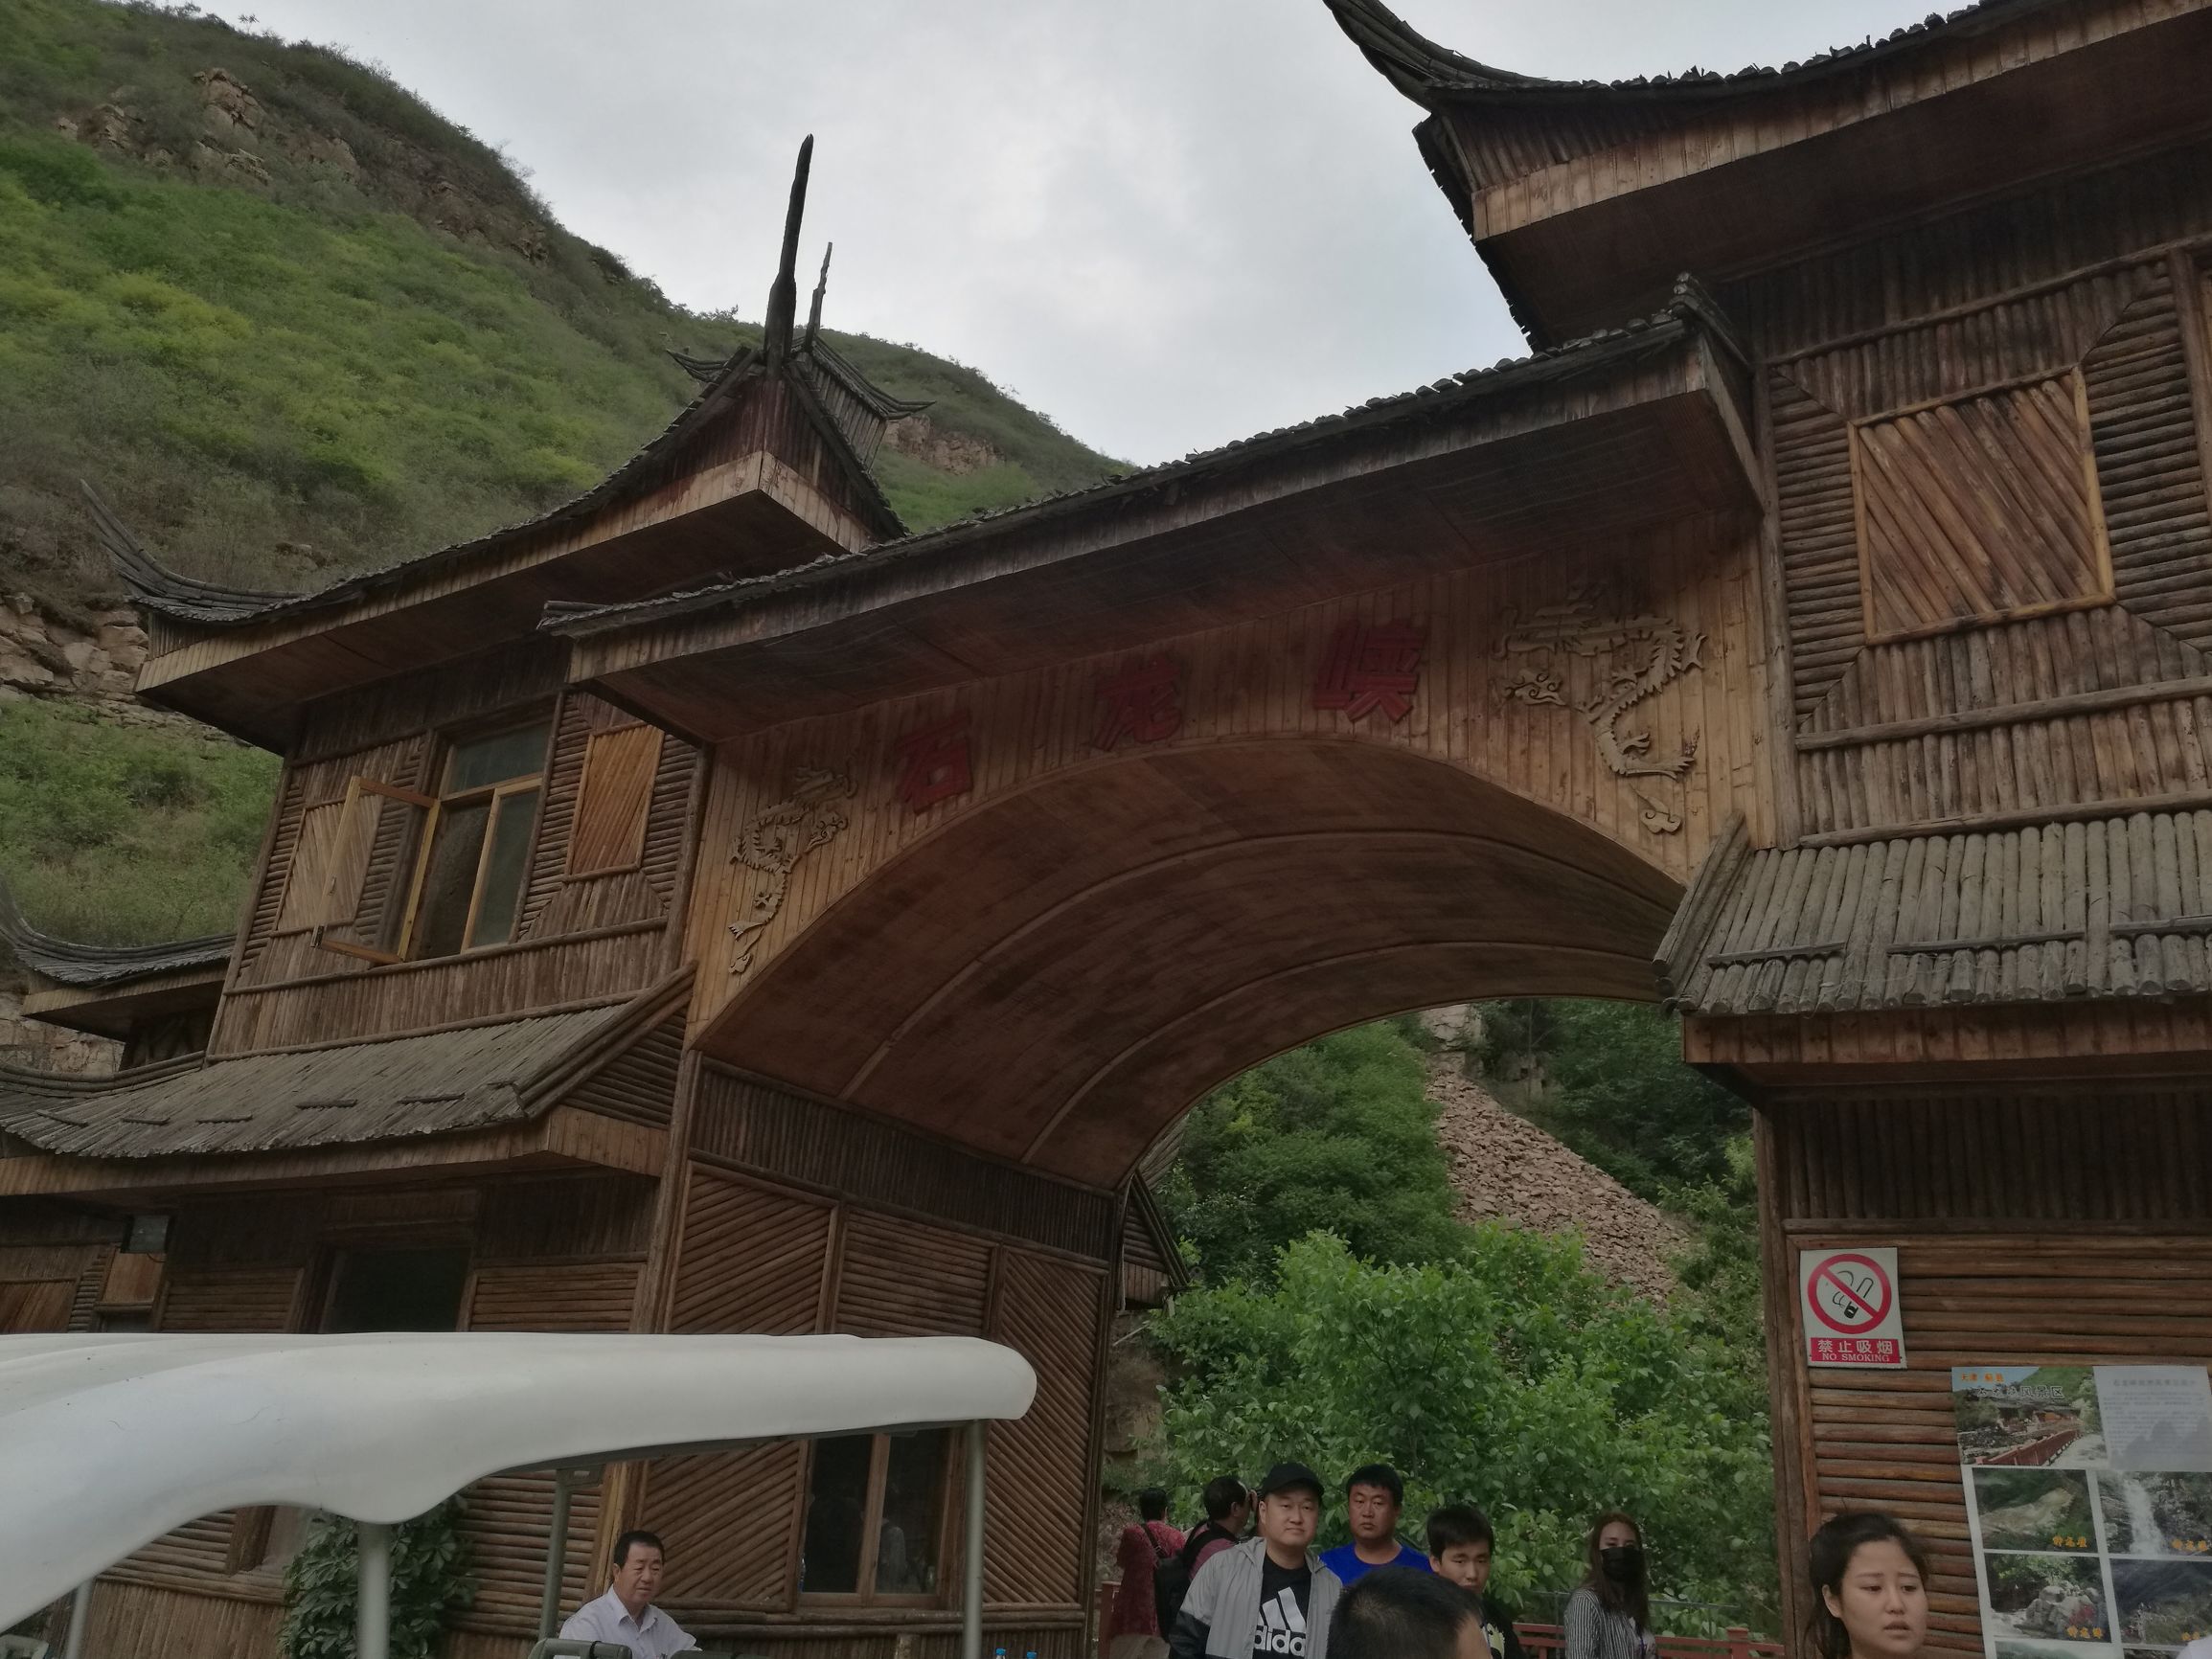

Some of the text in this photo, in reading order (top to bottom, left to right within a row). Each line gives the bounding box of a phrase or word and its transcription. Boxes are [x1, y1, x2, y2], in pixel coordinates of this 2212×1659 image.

[1817, 1339, 1893, 1354] 禁止吸烟
[1841, 1353, 1889, 1362] SMOKING
[1254, 1625, 1307, 1657] dida
